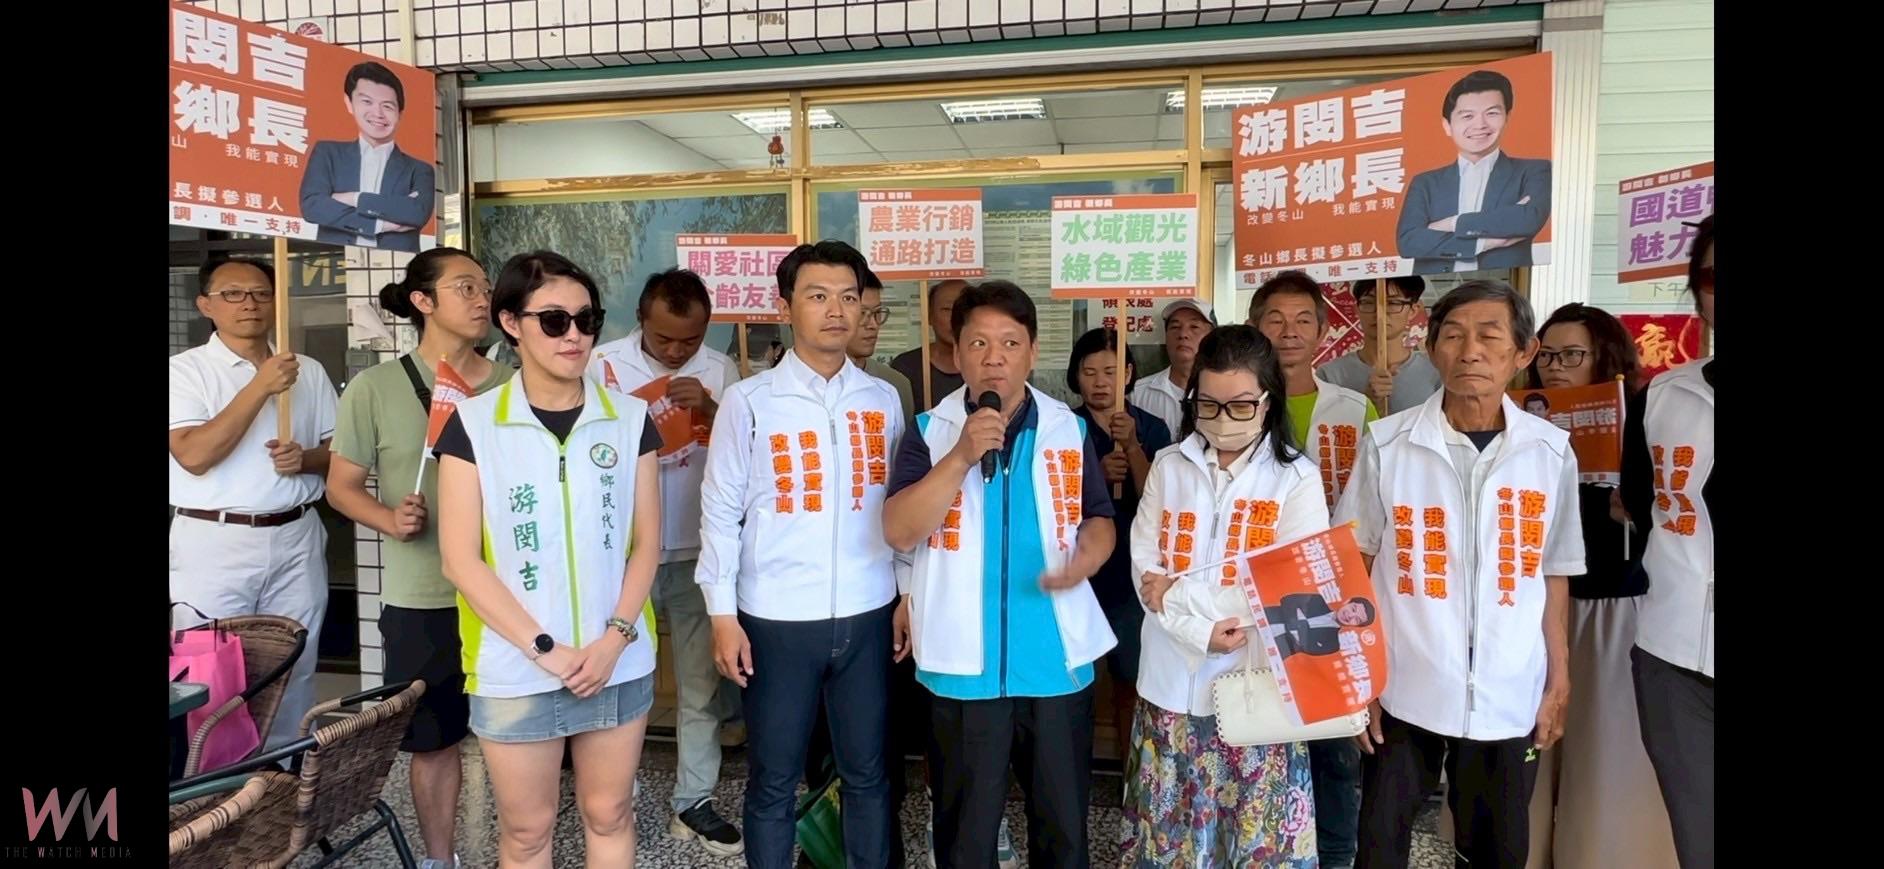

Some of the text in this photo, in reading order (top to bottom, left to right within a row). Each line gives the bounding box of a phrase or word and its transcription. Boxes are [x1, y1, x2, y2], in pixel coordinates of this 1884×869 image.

[172, 11, 308, 91] 閔吉
[173, 80, 309, 154] 鄉長
[1238, 88, 1405, 157] 游閔吉
[226, 143, 299, 168] 我能實現
[1240, 148, 1405, 212] 新鄉長
[174, 182, 283, 211] 長擬參選人
[869, 204, 974, 232] 農業行銷
[1061, 212, 1187, 244] 水域觀光
[1247, 197, 1395, 226] 改變冬山 我能實現
[688, 250, 790, 277] 關愛社區
[870, 237, 975, 266] 通路打造
[1061, 250, 1187, 283] 綠色產業
[1242, 240, 1382, 267] 冬山鄉長擬參選人
[706, 283, 781, 309] 齡友
[799, 430, 822, 512] 我能實現
[862, 411, 886, 486] 游閔吉
[1058, 449, 1081, 526] 游閔吉
[509, 483, 540, 592] 游閔吉
[1392, 505, 1415, 596] 改變冬山
[1423, 506, 1448, 600] 我能實現
[1518, 489, 1546, 578] 游閔吉
